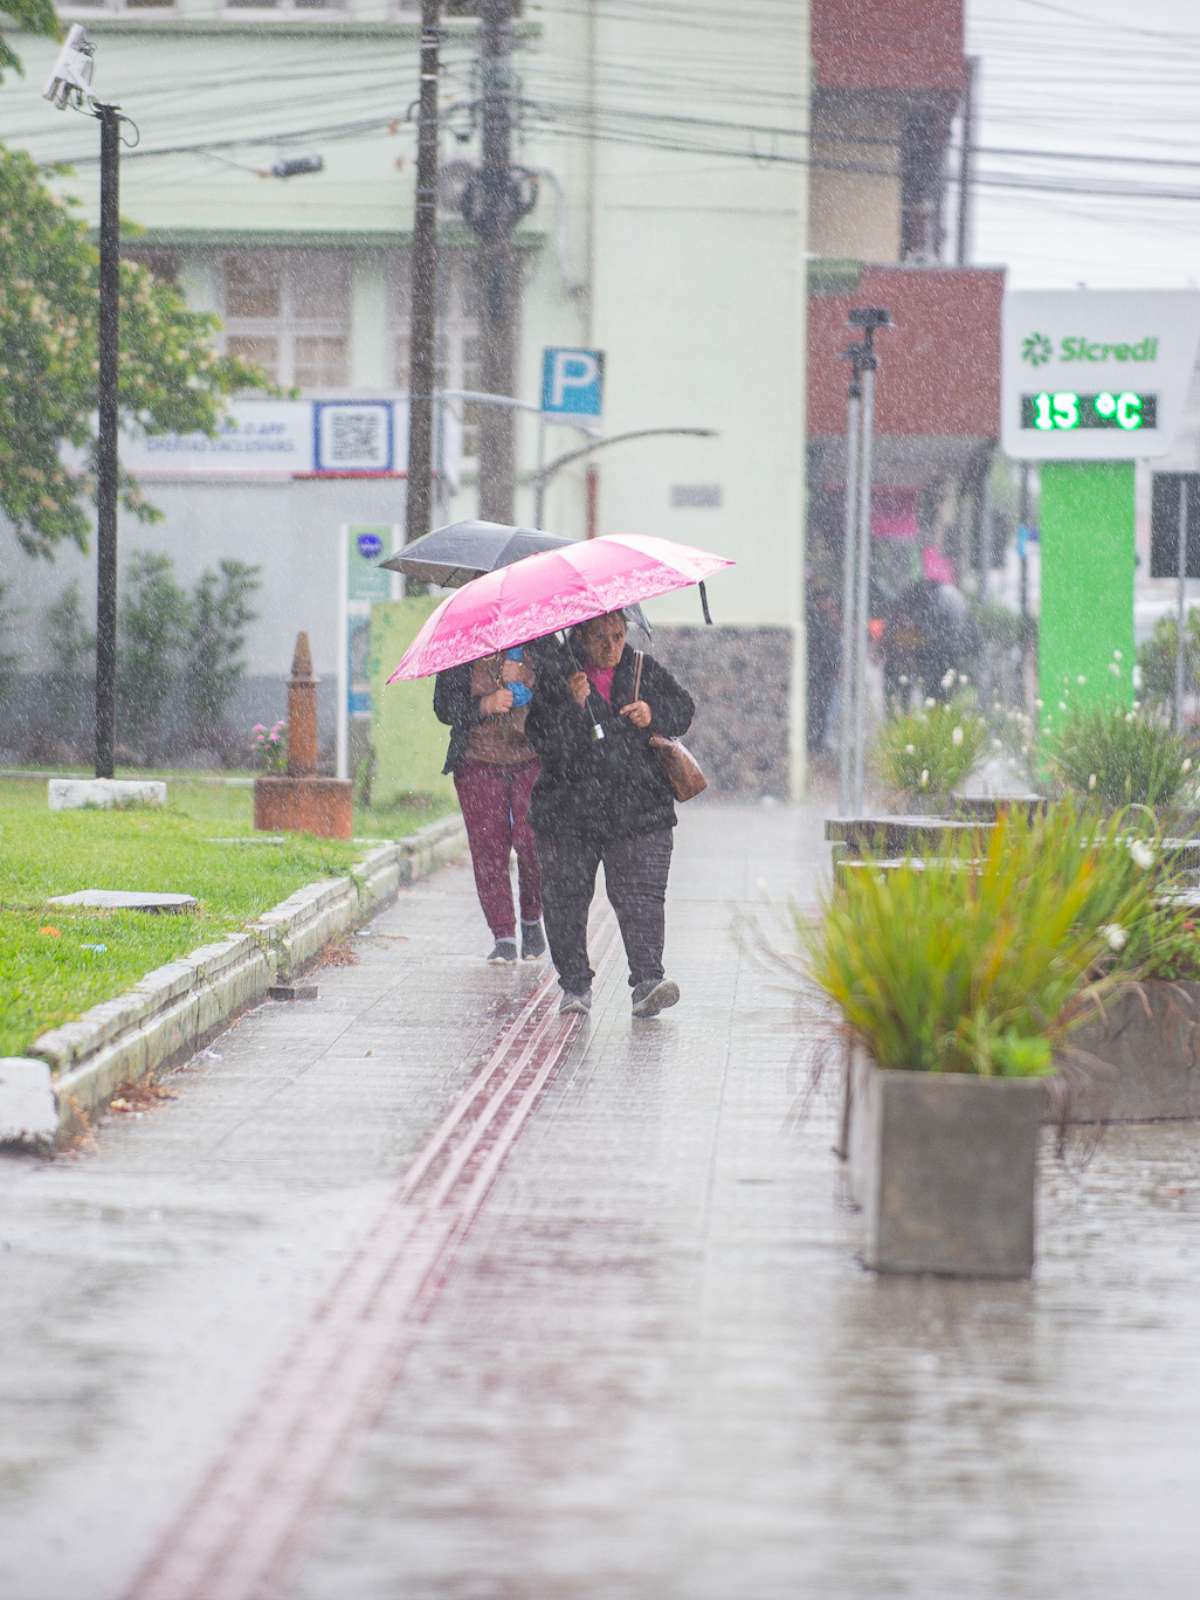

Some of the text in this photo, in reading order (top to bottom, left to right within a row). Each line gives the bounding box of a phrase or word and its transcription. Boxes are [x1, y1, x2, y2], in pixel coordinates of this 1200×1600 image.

[1060, 336, 1159, 362] Sicredi
[552, 351, 596, 406] P
[1034, 391, 1080, 431] 15
